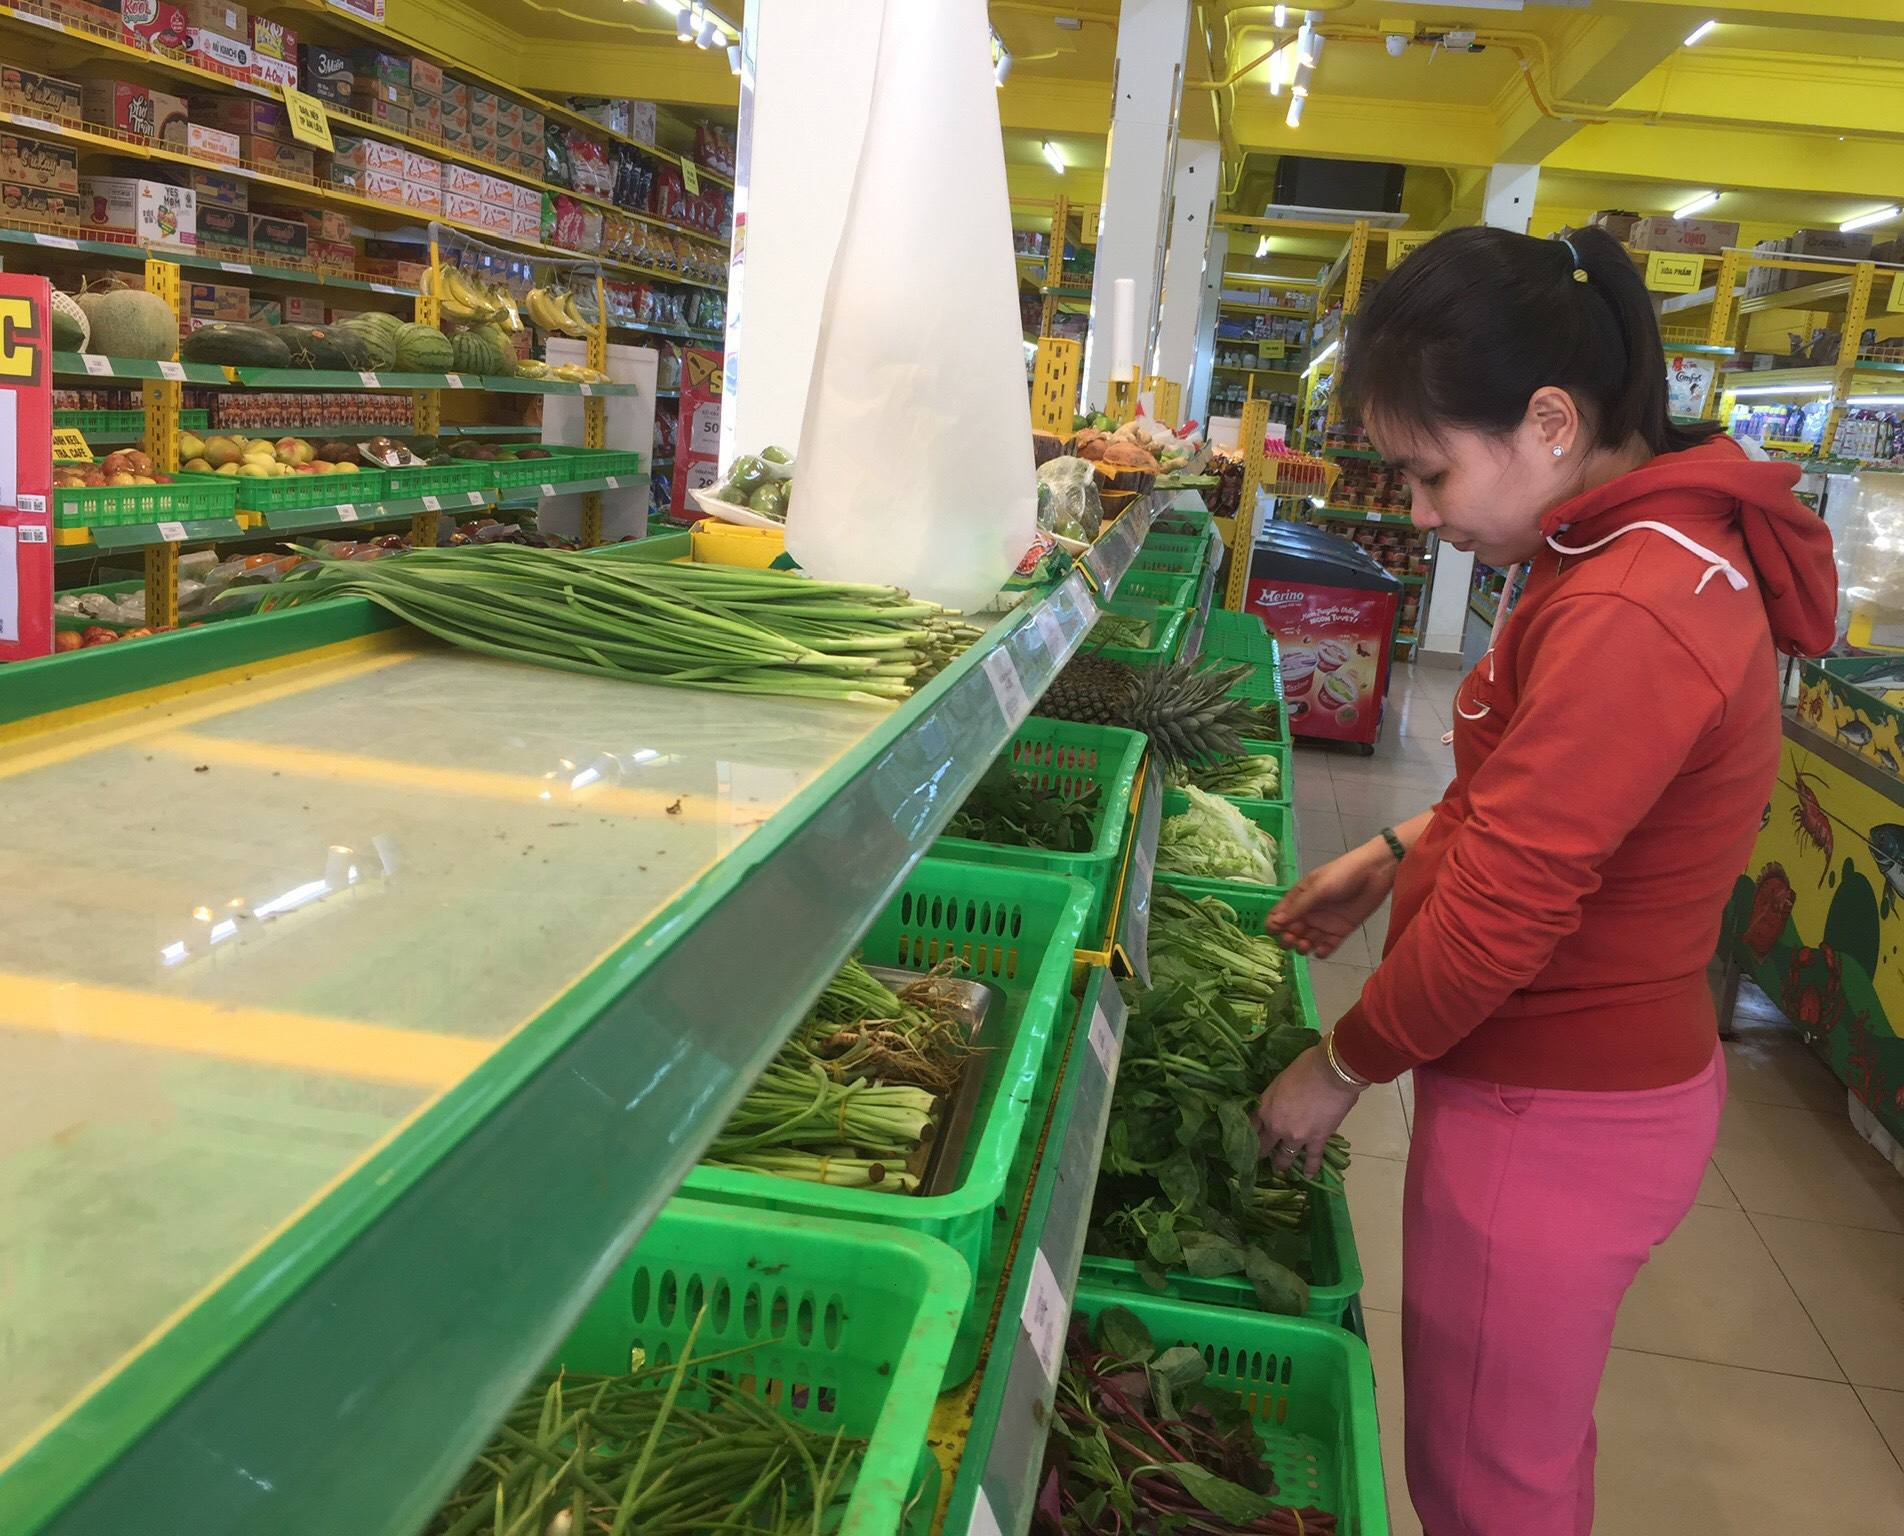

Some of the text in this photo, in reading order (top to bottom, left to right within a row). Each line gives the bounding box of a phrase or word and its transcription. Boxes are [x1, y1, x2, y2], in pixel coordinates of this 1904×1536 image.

[165, 186, 178, 196] YES
[164, 195, 180, 207] MOM
[1684, 232, 1706, 245] OMO
[1818, 238, 1846, 248] ARIEL
[1259, 588, 1304, 602] Merino
